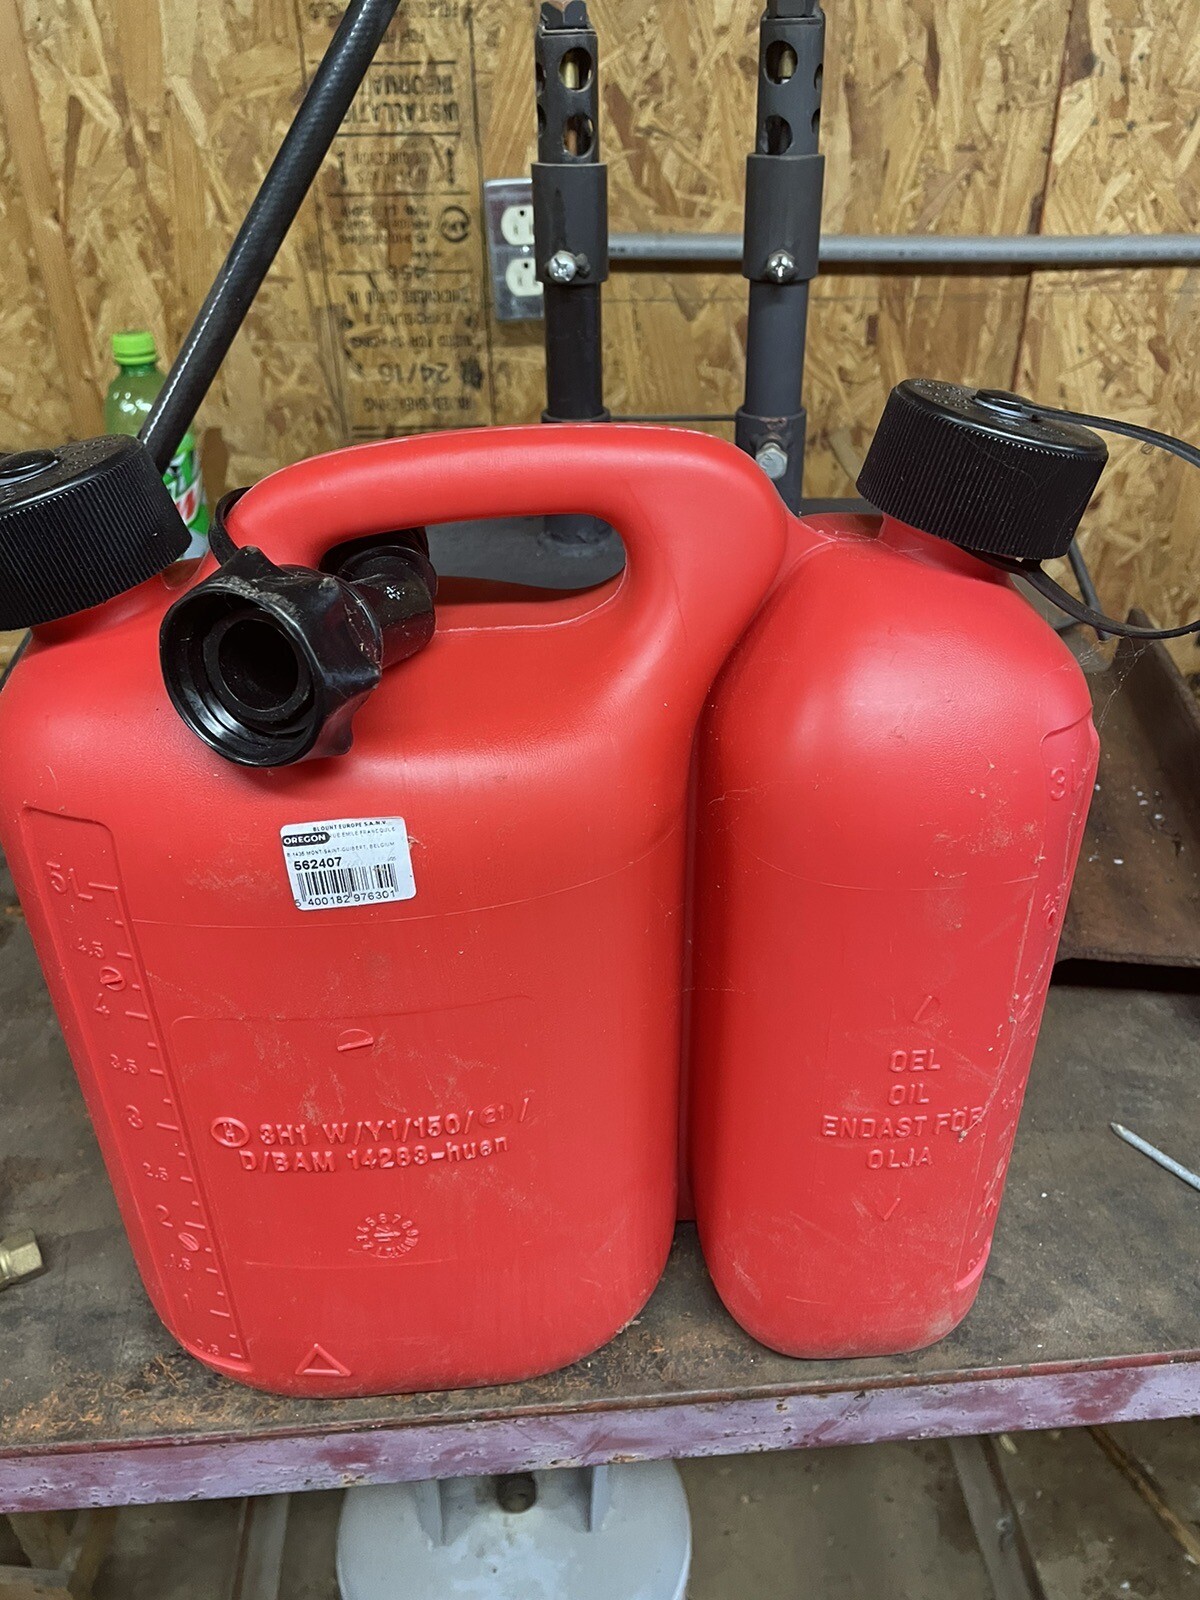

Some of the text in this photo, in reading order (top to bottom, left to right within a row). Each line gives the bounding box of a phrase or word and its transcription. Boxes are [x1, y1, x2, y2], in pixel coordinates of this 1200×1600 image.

[378, 362, 451, 384] 24/16
[313, 824, 338, 832] BLOUNT
[339, 822, 362, 830] EUROPE
[283, 834, 326, 845] OREGON
[294, 857, 342, 870] 562407
[308, 893, 350, 906] 400182
[354, 889, 396, 902] 976301
[889, 1048, 941, 1073] OEL
[888, 1083, 930, 1106] OIL
[821, 1114, 928, 1139] ENDAST
[238, 1149, 337, 1173] D/BAM
[866, 1146, 934, 1170] OLJA
